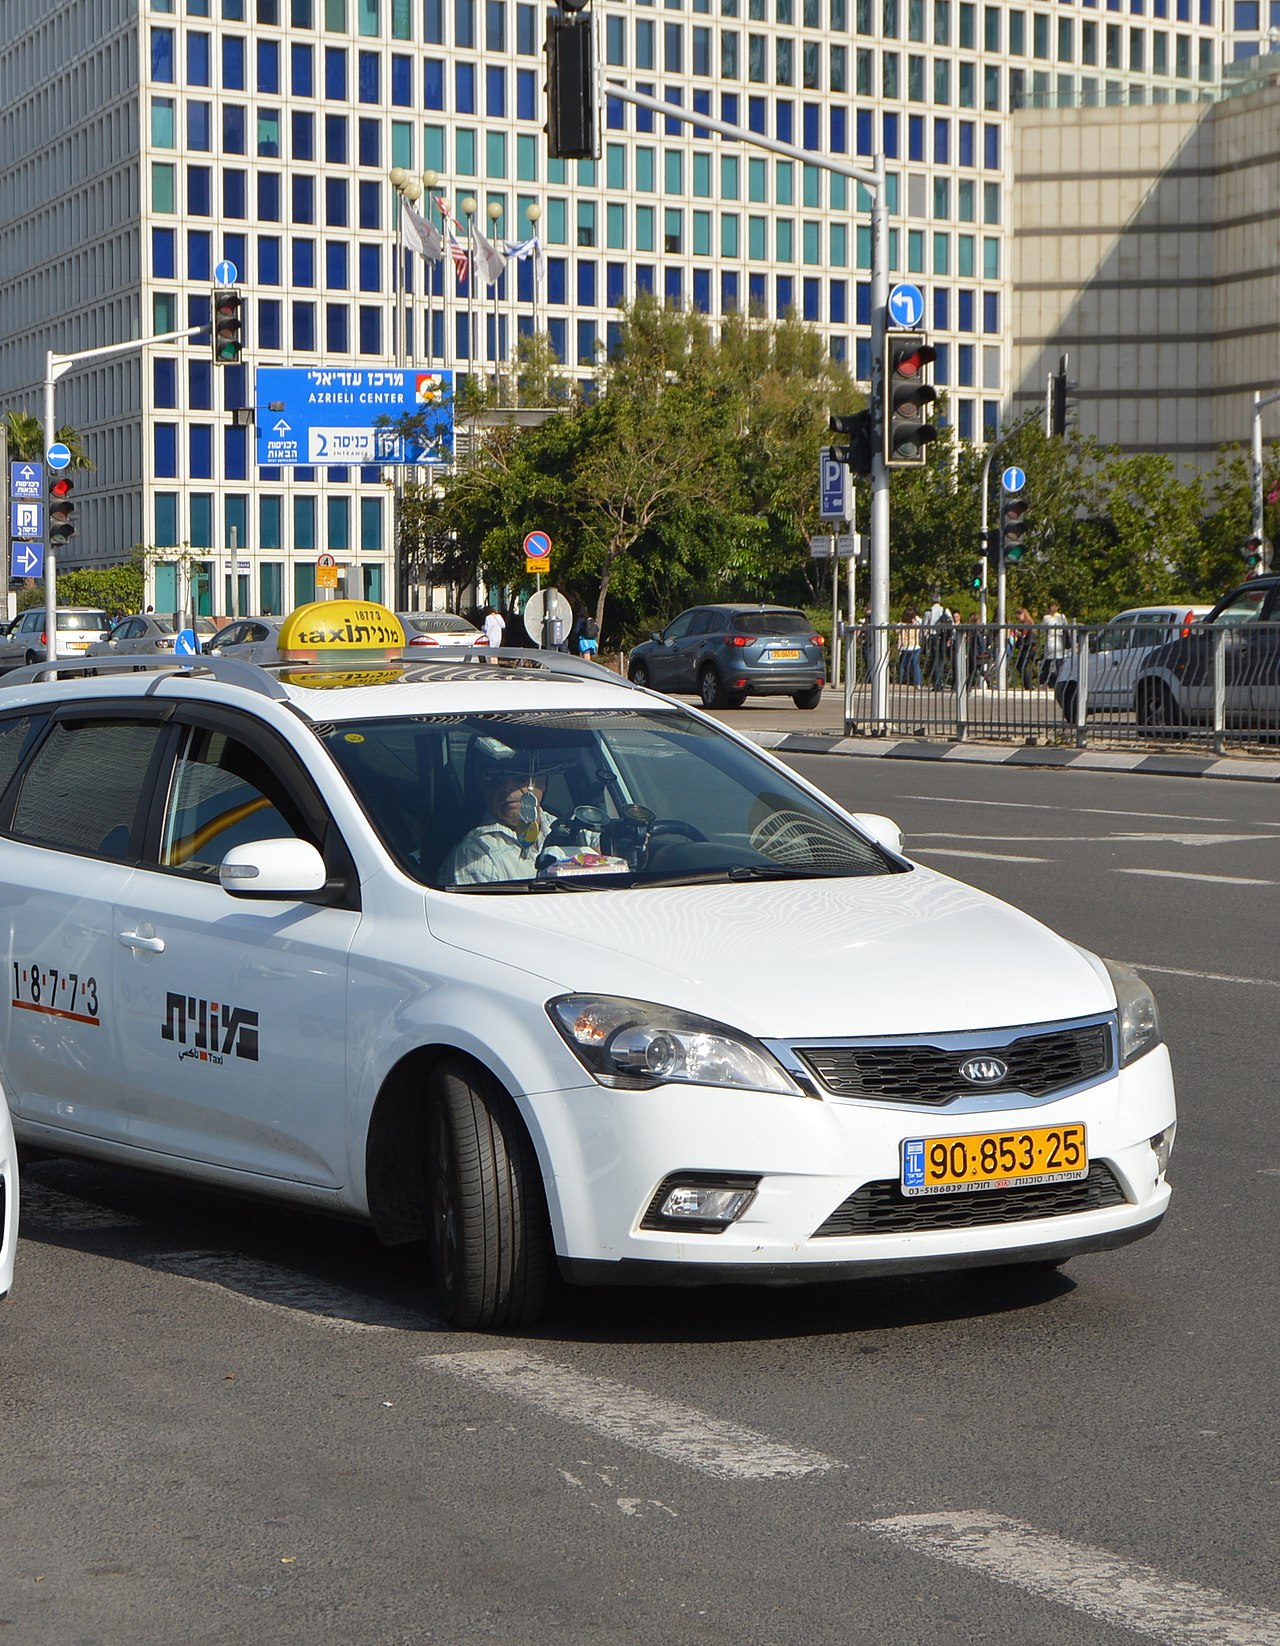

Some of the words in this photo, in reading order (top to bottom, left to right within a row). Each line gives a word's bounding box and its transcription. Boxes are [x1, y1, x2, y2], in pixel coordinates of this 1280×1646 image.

[307, 371, 363, 387] עזריאלי
[367, 372, 404, 387] מרכז
[308, 392, 354, 404] AZRIELI
[359, 392, 404, 404] CENTER
[267, 439, 298, 449] לכניסות
[315, 432, 328, 457] 2
[333, 434, 368, 448] כניסה
[267, 450, 298, 459] הבאות
[355, 610, 382, 621] 18773
[298, 618, 354, 644] taxi
[354, 624, 399, 643] מונית
[161, 991, 259, 1062] מונית
[208, 1052, 224, 1065] Taxi
[968, 1061, 1001, 1079] KIA
[909, 1155, 922, 1173] IL
[966, 1181, 990, 1191] חולון
[1014, 1177, 1043, 1187] סוכנות
[908, 1184, 962, 1195] 03-5186839
